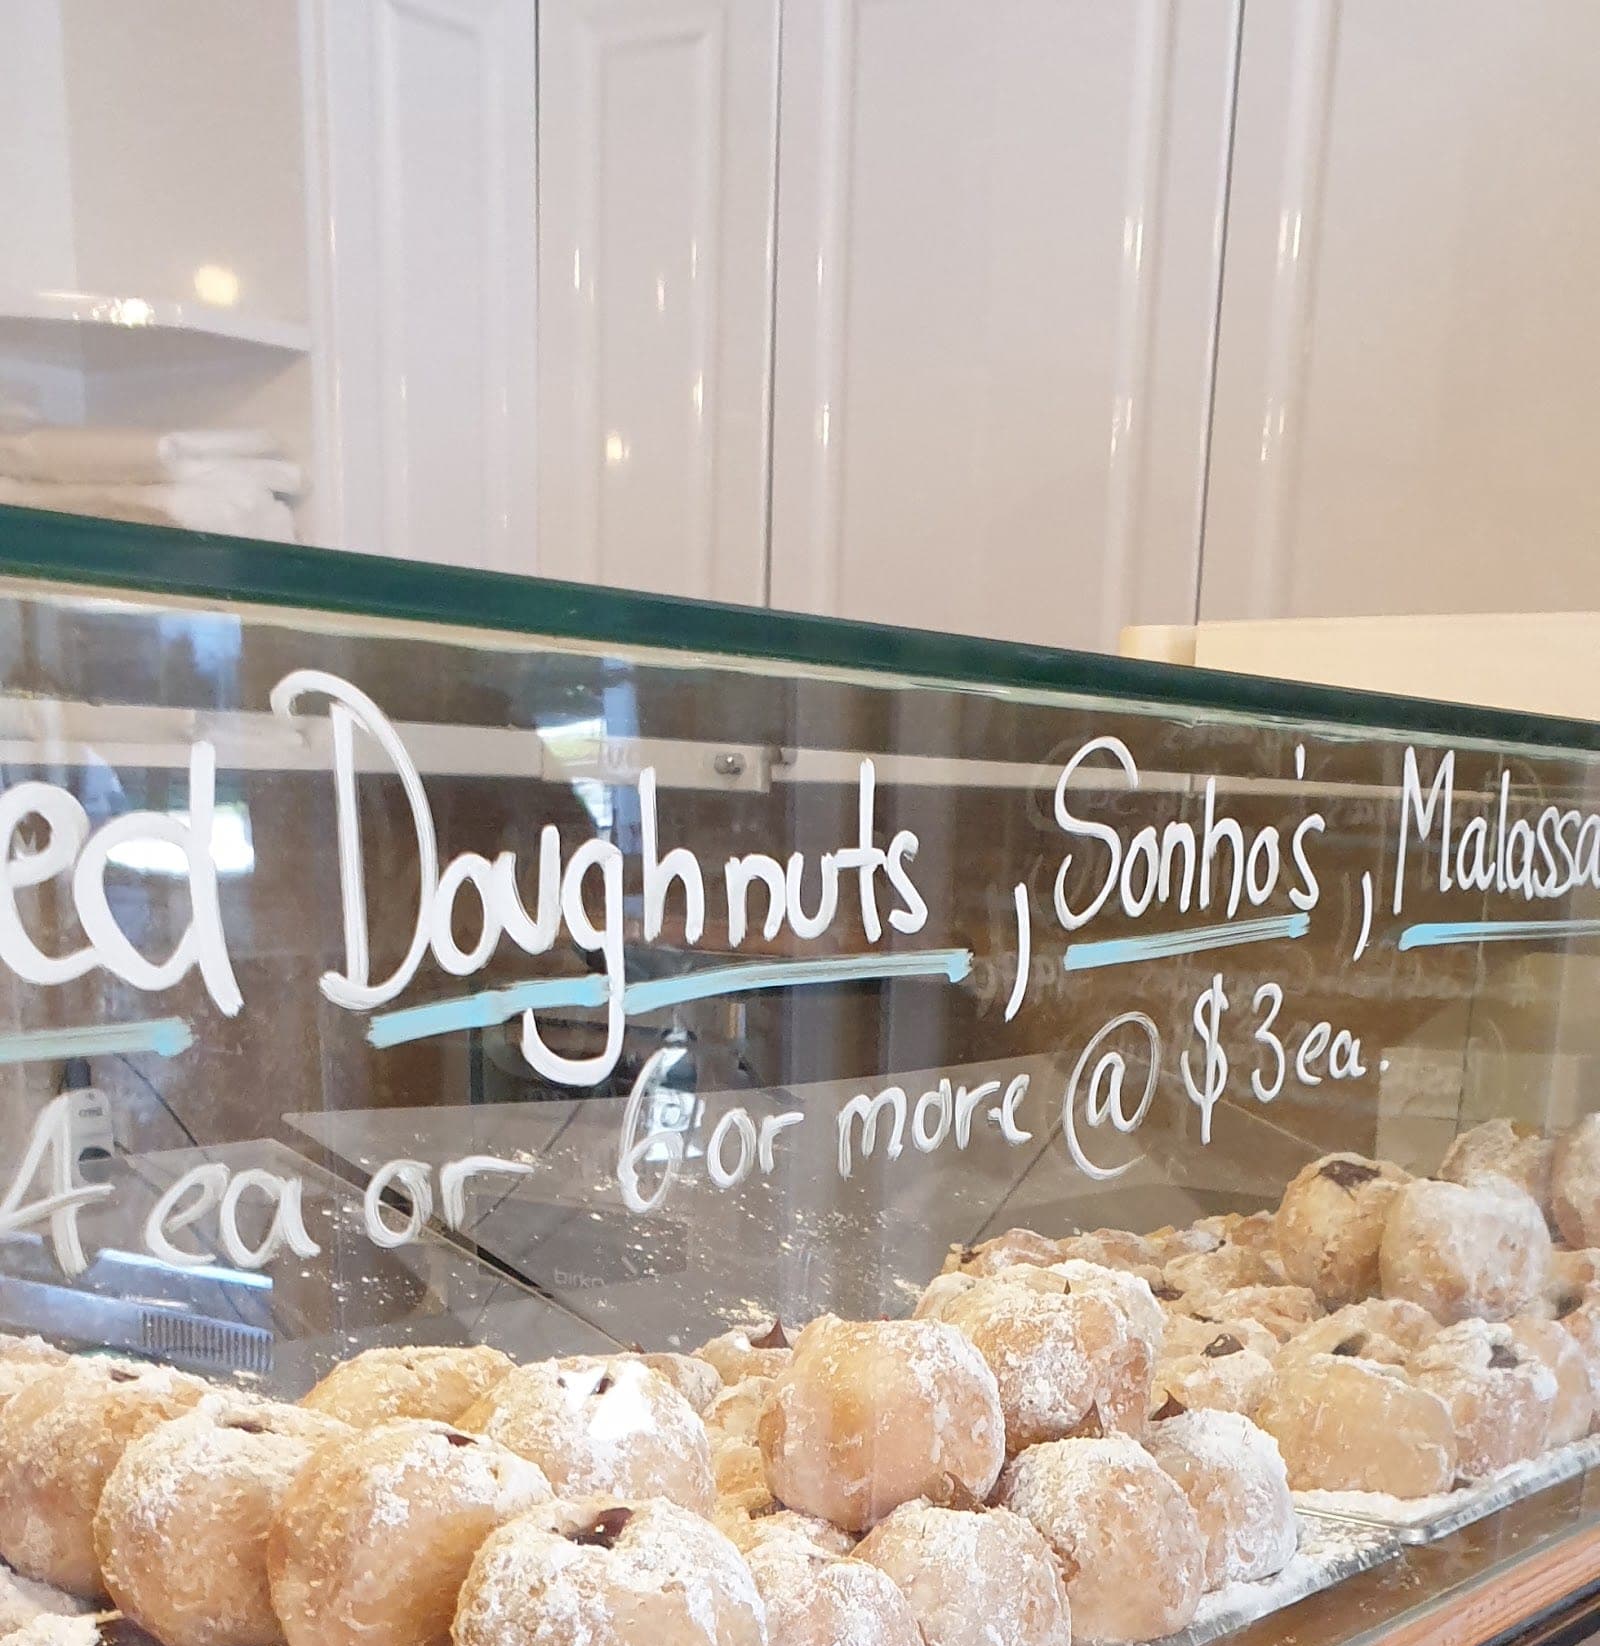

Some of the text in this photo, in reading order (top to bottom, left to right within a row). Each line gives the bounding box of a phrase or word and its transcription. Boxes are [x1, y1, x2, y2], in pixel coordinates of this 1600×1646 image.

[0, 740, 243, 1017] ed
[269, 668, 930, 1087] Doughnuts
[364, 1155, 535, 1249] or
[837, 1073, 1033, 1181] more
